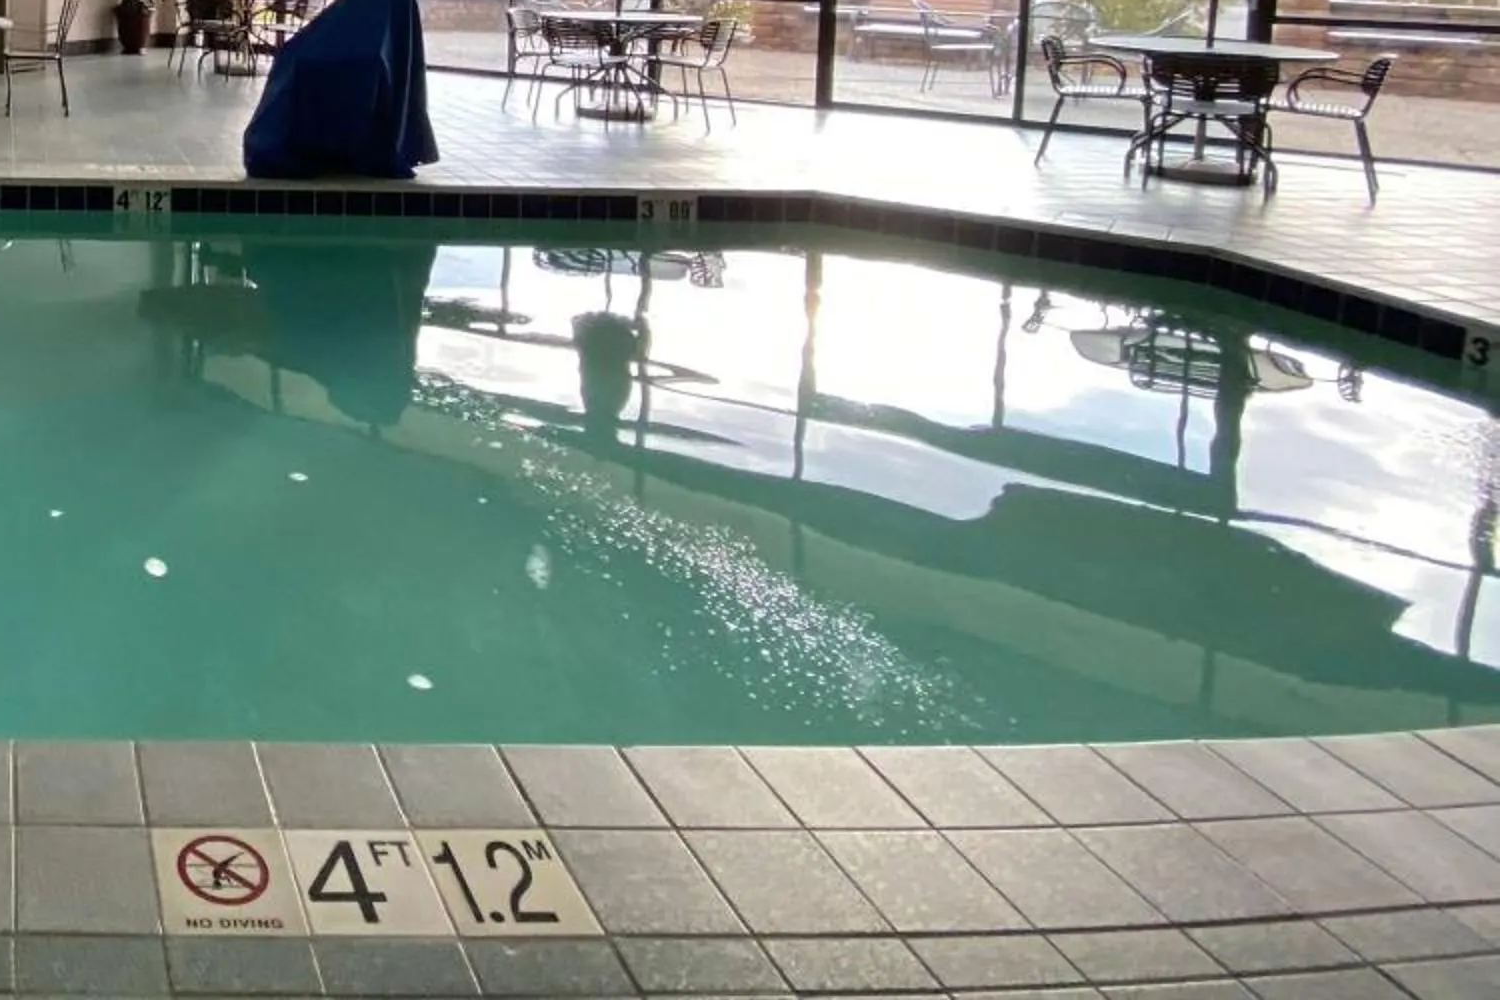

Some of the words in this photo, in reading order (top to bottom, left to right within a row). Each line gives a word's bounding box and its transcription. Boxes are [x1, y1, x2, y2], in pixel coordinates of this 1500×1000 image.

[116, 190, 129, 211] 4
[641, 199, 654, 219] 3
[1468, 337, 1490, 366] 3
[185, 918, 213, 929] NO
[219, 918, 284, 929] DIVING
